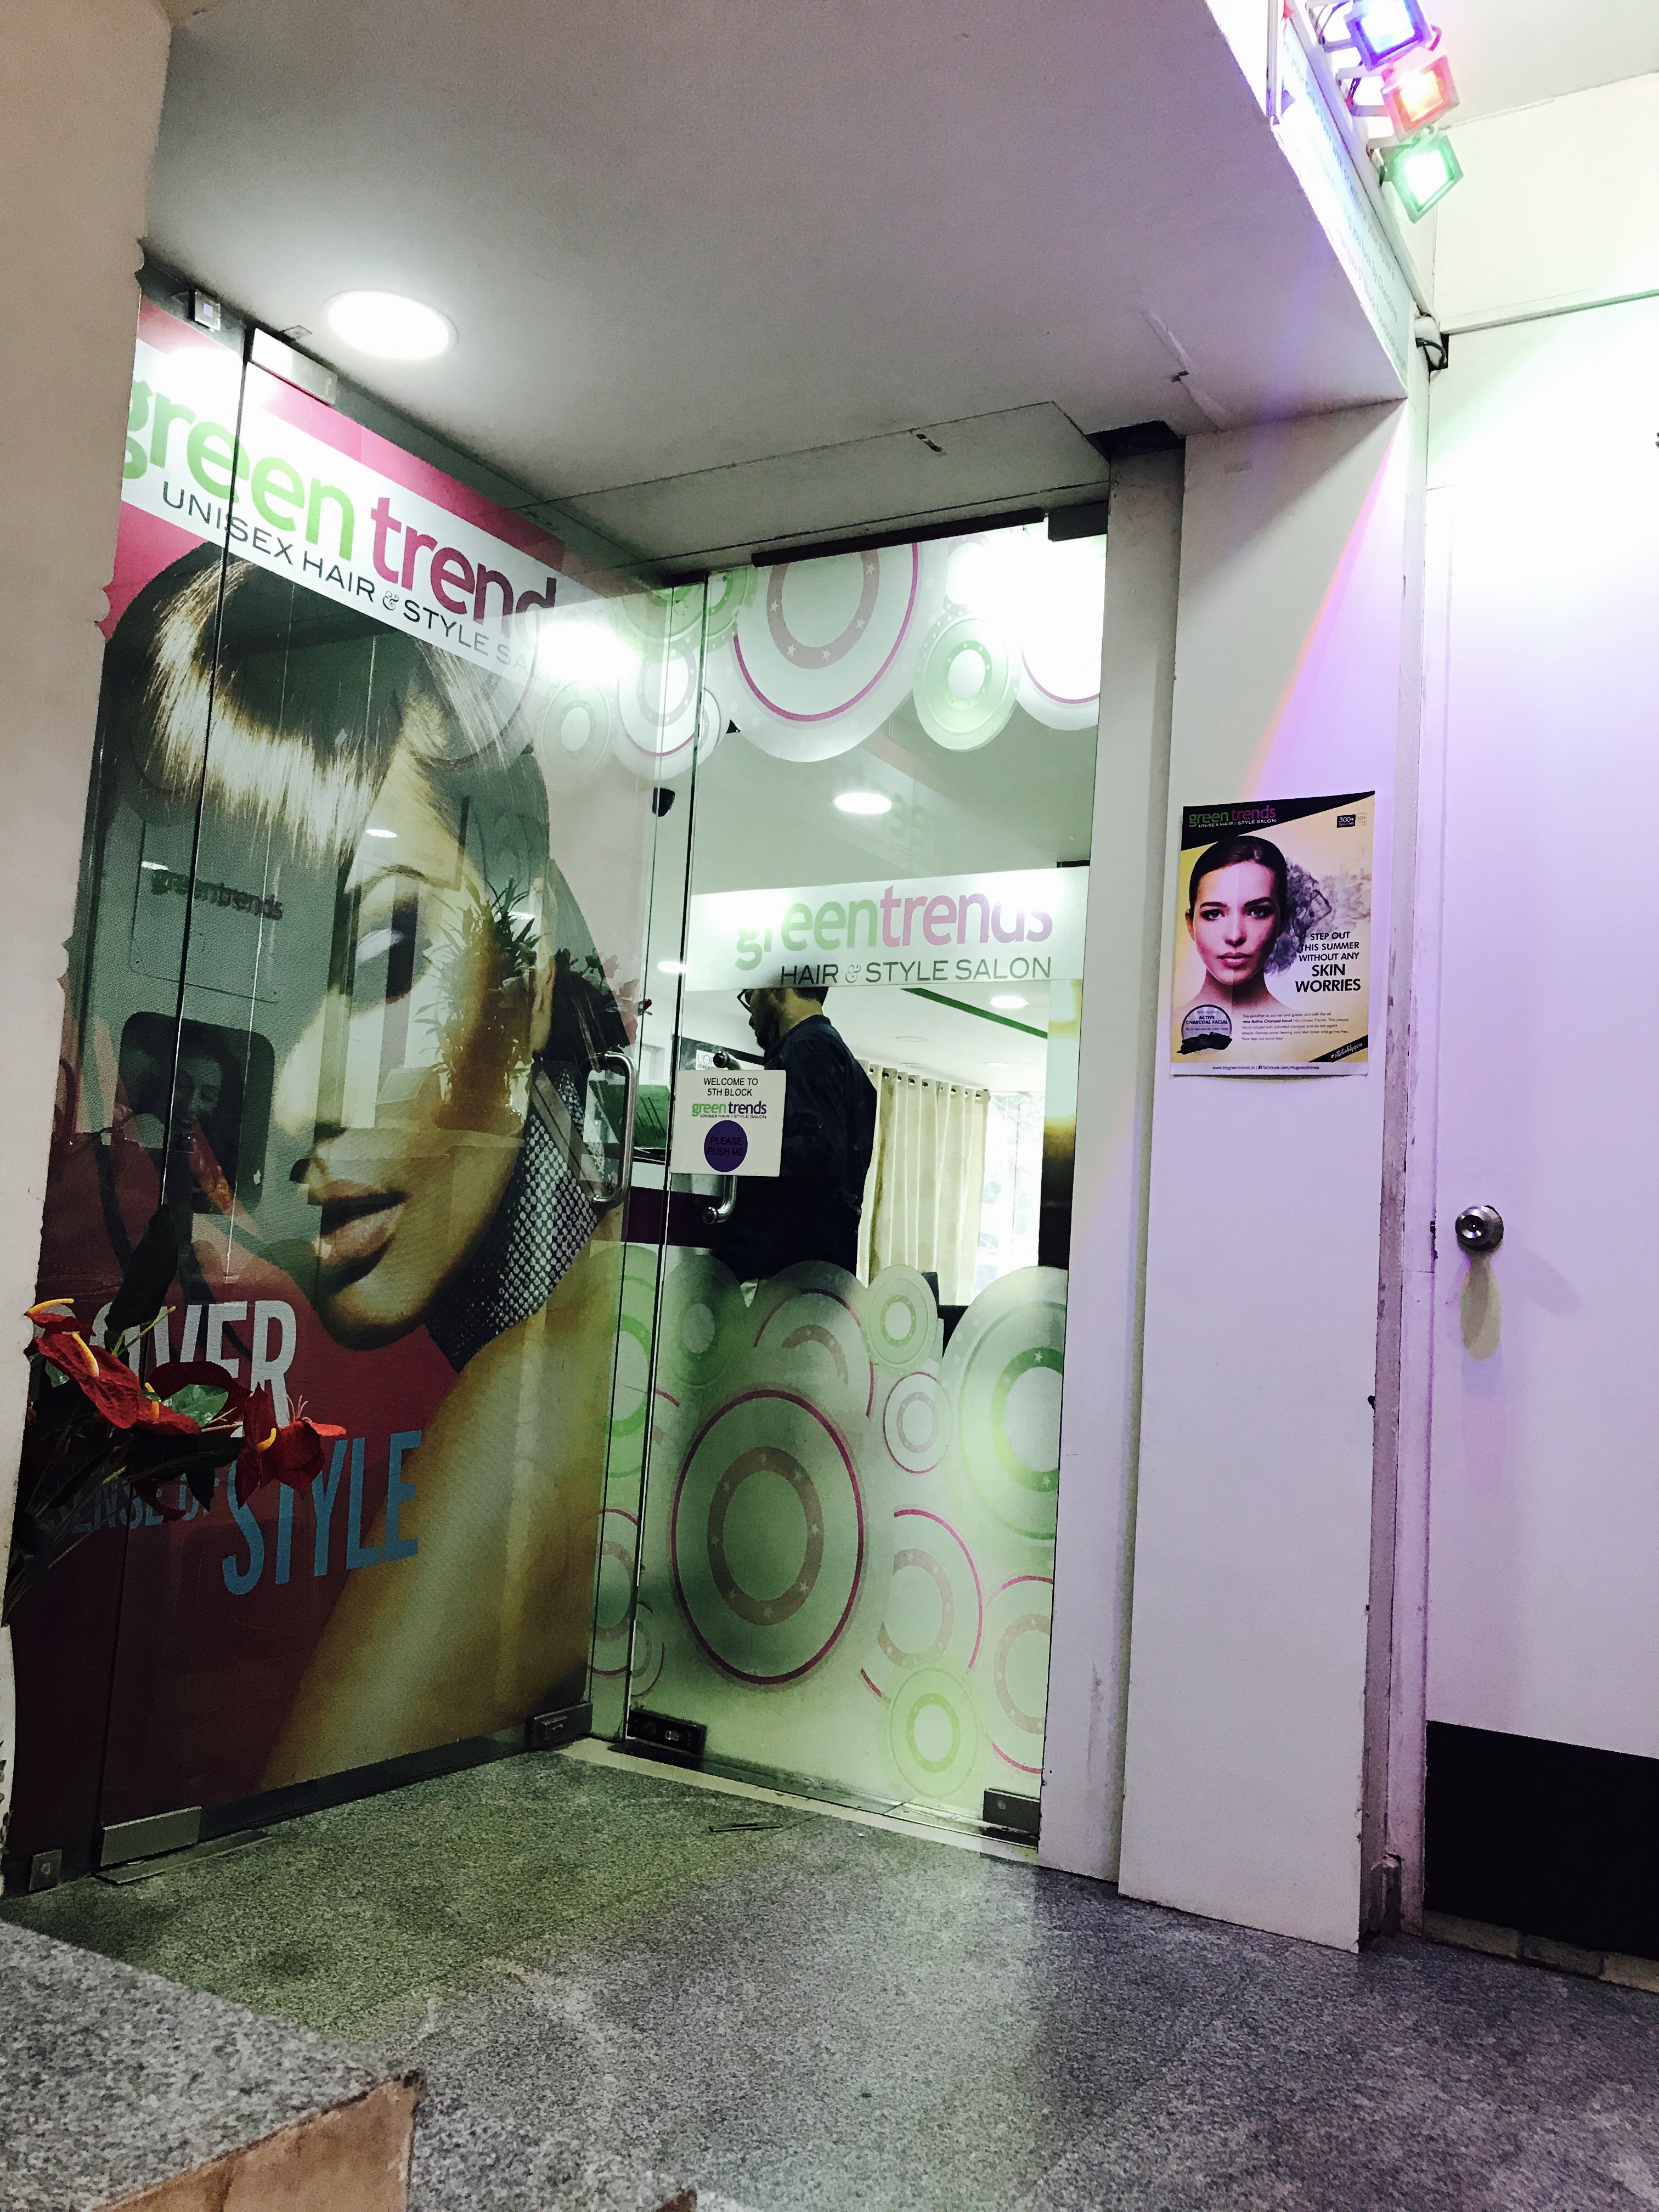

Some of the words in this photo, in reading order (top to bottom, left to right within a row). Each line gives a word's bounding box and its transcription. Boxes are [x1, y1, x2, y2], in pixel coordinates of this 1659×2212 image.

[122, 380, 357, 562] green
[371, 497, 556, 639] trend
[162, 481, 293, 566] UNISEX
[303, 550, 375, 604] HAIR
[382, 591, 399, 611] &
[404, 600, 489, 654] STYLE
[1189, 811, 1229, 827] green
[1232, 805, 1276, 821] trends
[1322, 942, 1359, 950] SUMMER
[1299, 953, 1339, 962] WITHOUT
[781, 964, 839, 985] HAIR
[866, 961, 949, 983] STYLE
[955, 957, 1052, 980] SALON
[1312, 964, 1345, 977] SKIN
[1295, 979, 1361, 992] WORRIES
[692, 1103, 726, 1116] green
[729, 1101, 766, 1114] trends
[710, 1137, 742, 1146] PLEASE
[708, 1148, 730, 1156] PUSH
[731, 1148, 743, 1156] ME
